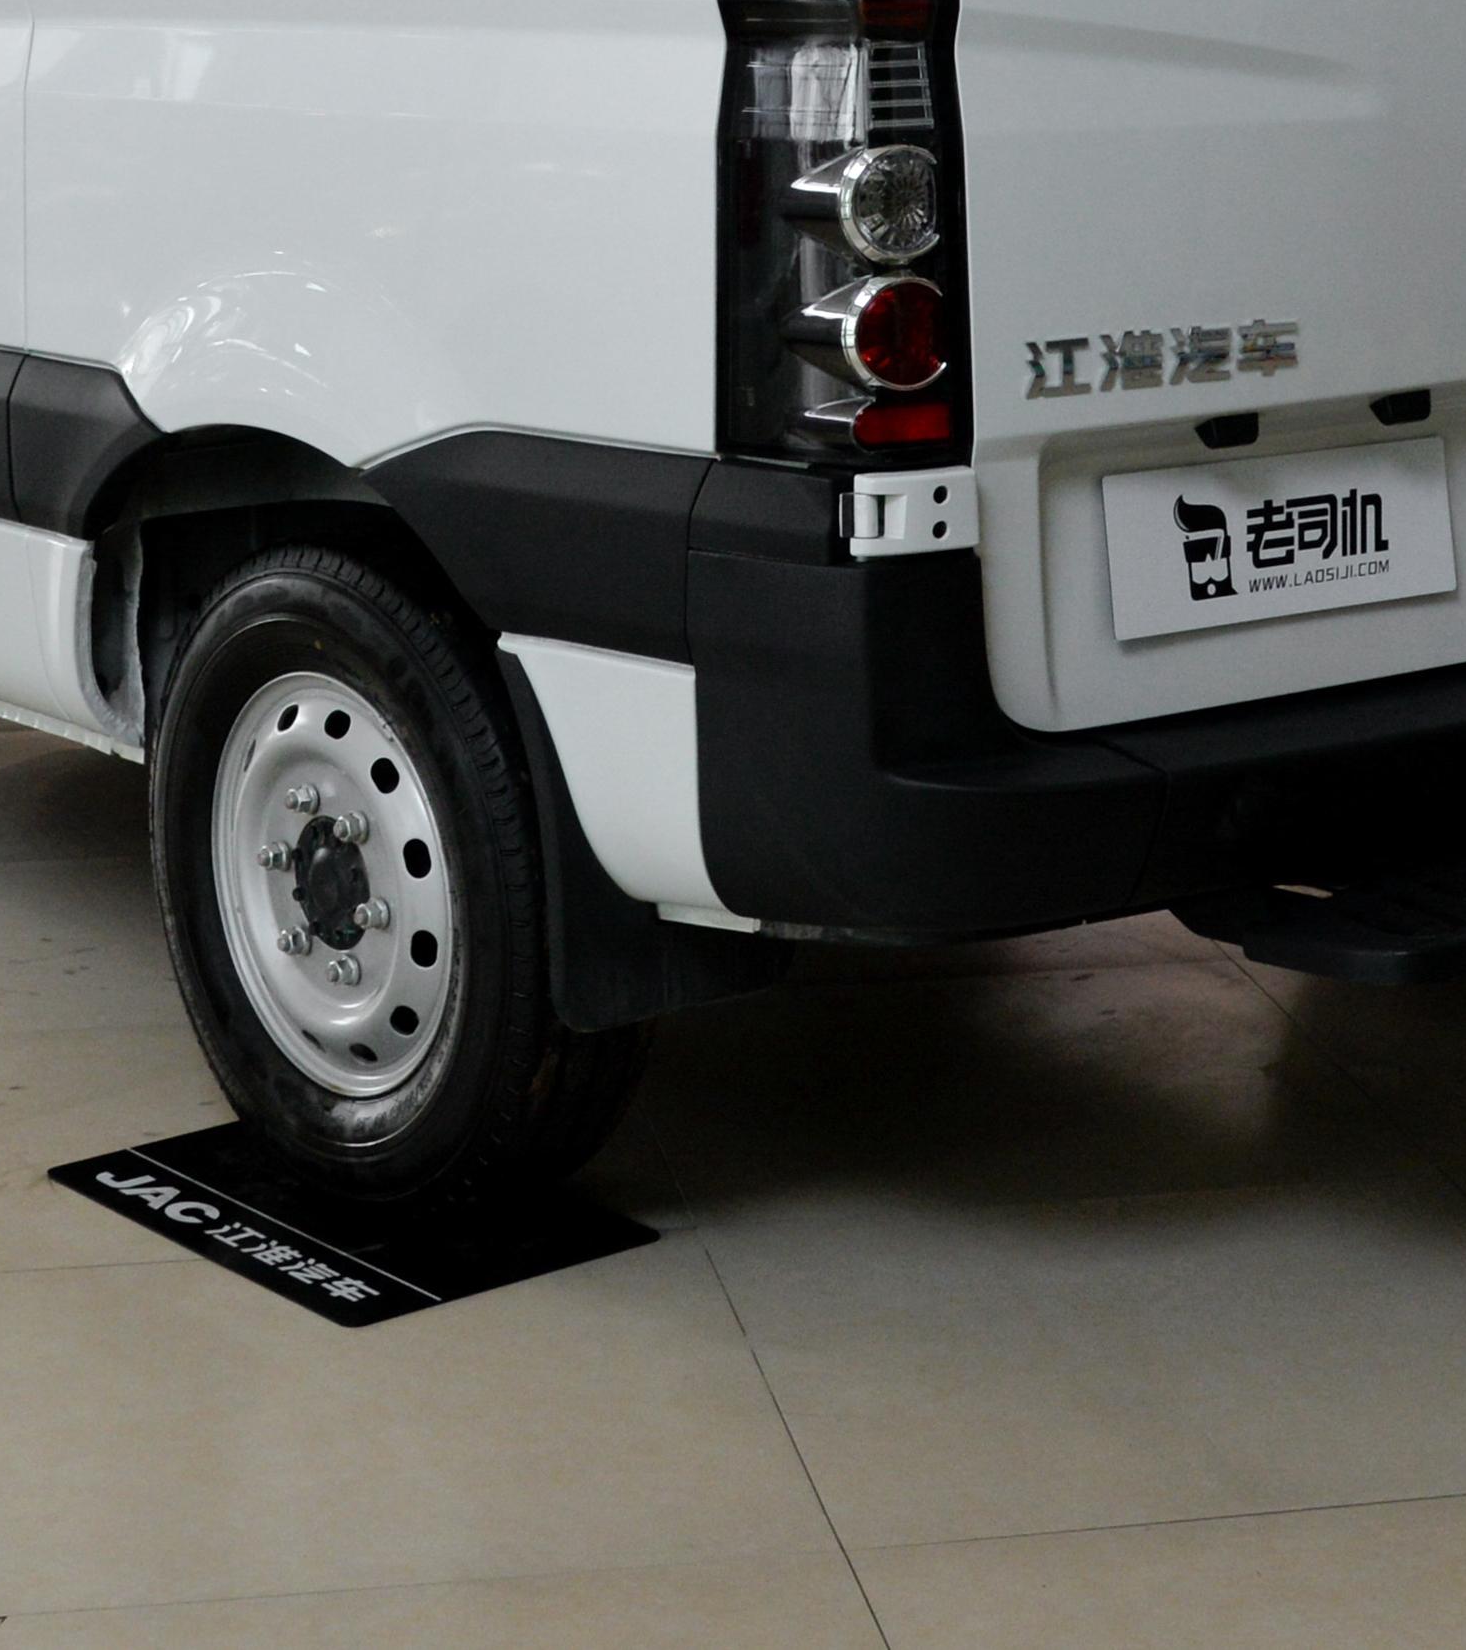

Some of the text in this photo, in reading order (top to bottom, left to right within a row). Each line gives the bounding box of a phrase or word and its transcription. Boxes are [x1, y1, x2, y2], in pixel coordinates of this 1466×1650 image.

[1025, 319, 1300, 400] 江淮汽车
[1246, 488, 1389, 569] 老司机
[1248, 559, 1390, 594] WWW.LAOSIJI.COM
[95, 1171, 381, 1302] JAC 江淮汽车
